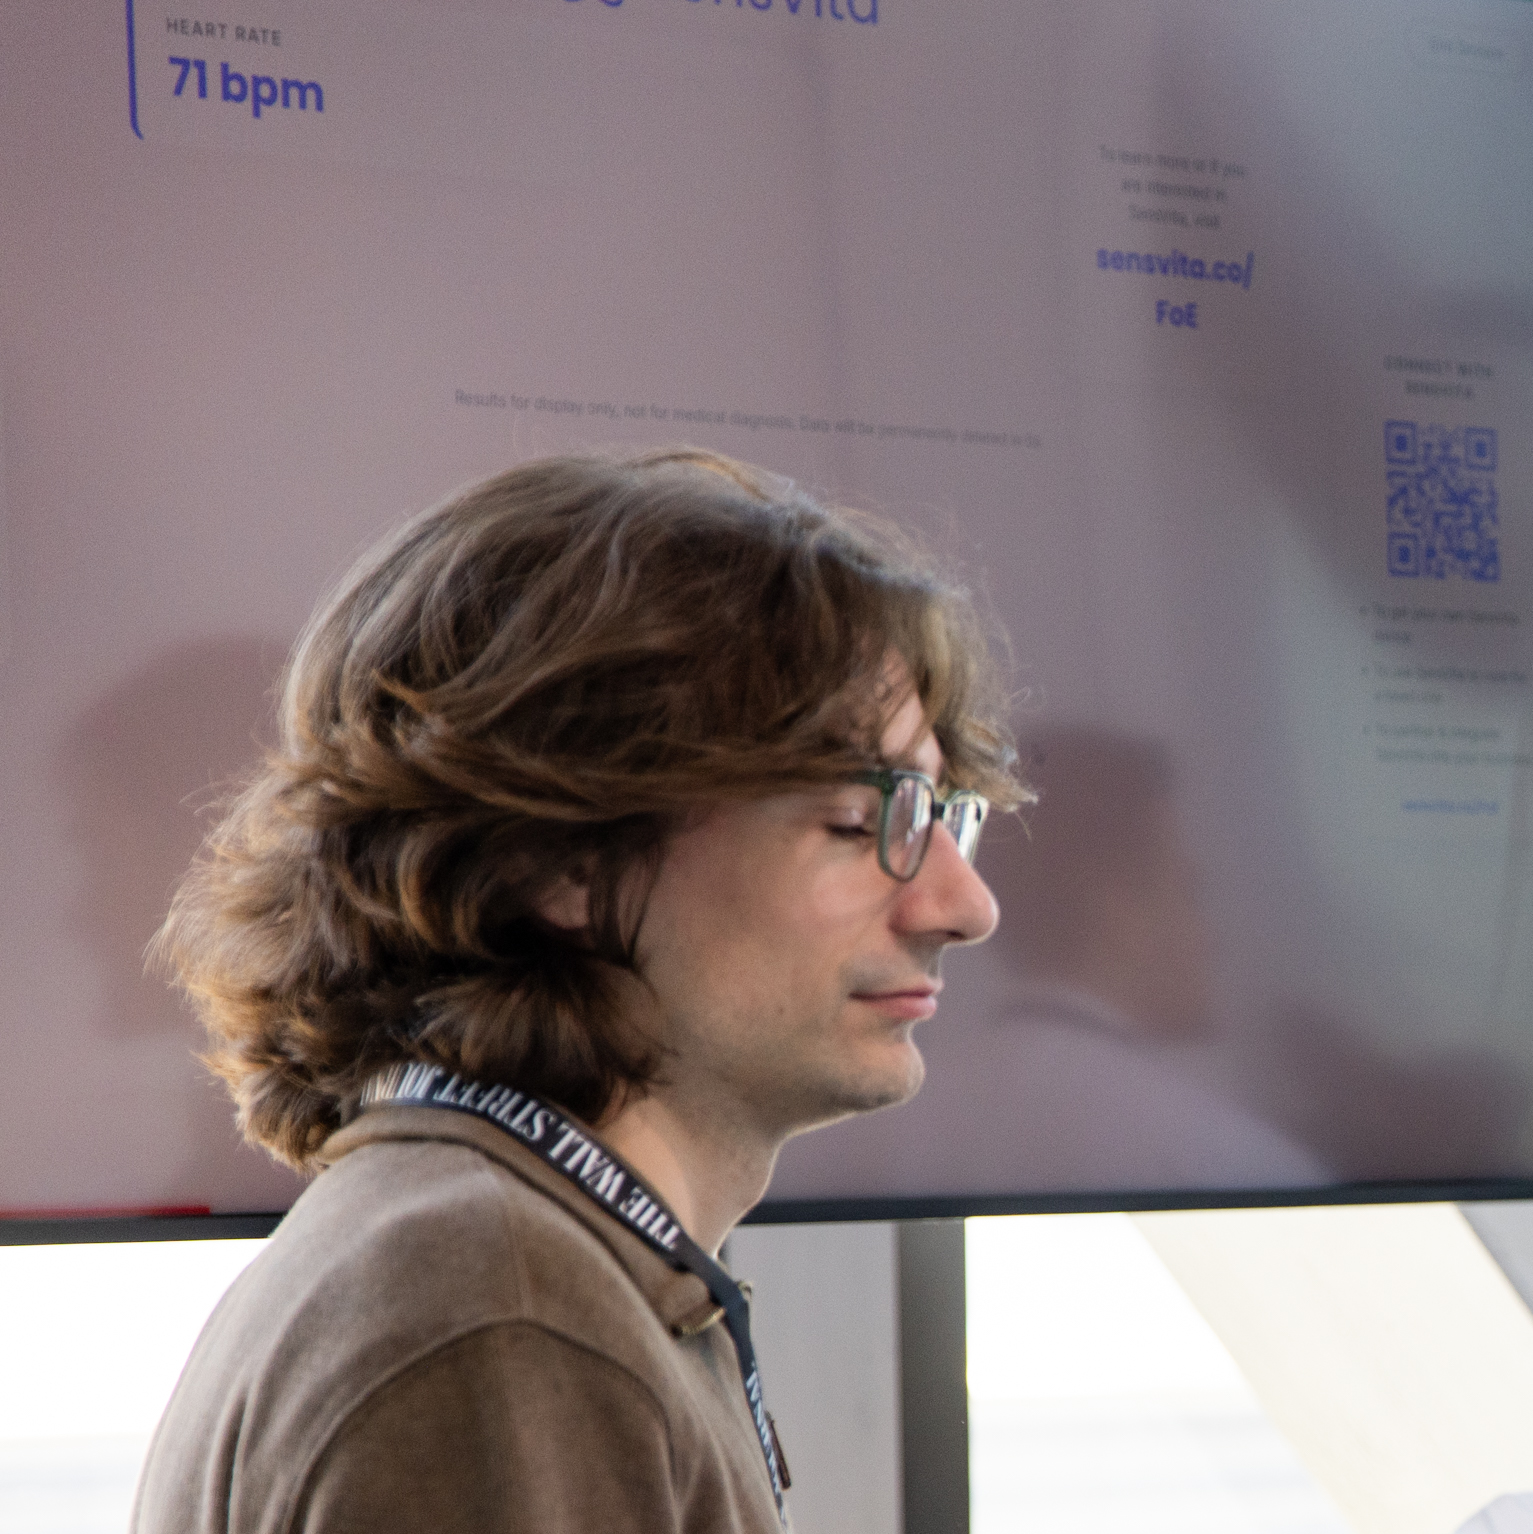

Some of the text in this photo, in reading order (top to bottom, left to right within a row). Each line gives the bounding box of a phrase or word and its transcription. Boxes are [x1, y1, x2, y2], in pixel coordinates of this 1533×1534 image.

[166, 17, 281, 47] HEART RATE
[169, 55, 324, 119] 71 bpm
[1096, 248, 1255, 290] sensvita.co/
[1155, 299, 1198, 328] FoE
[548, 1121, 625, 1202] WALL
[619, 1187, 680, 1250] THE
